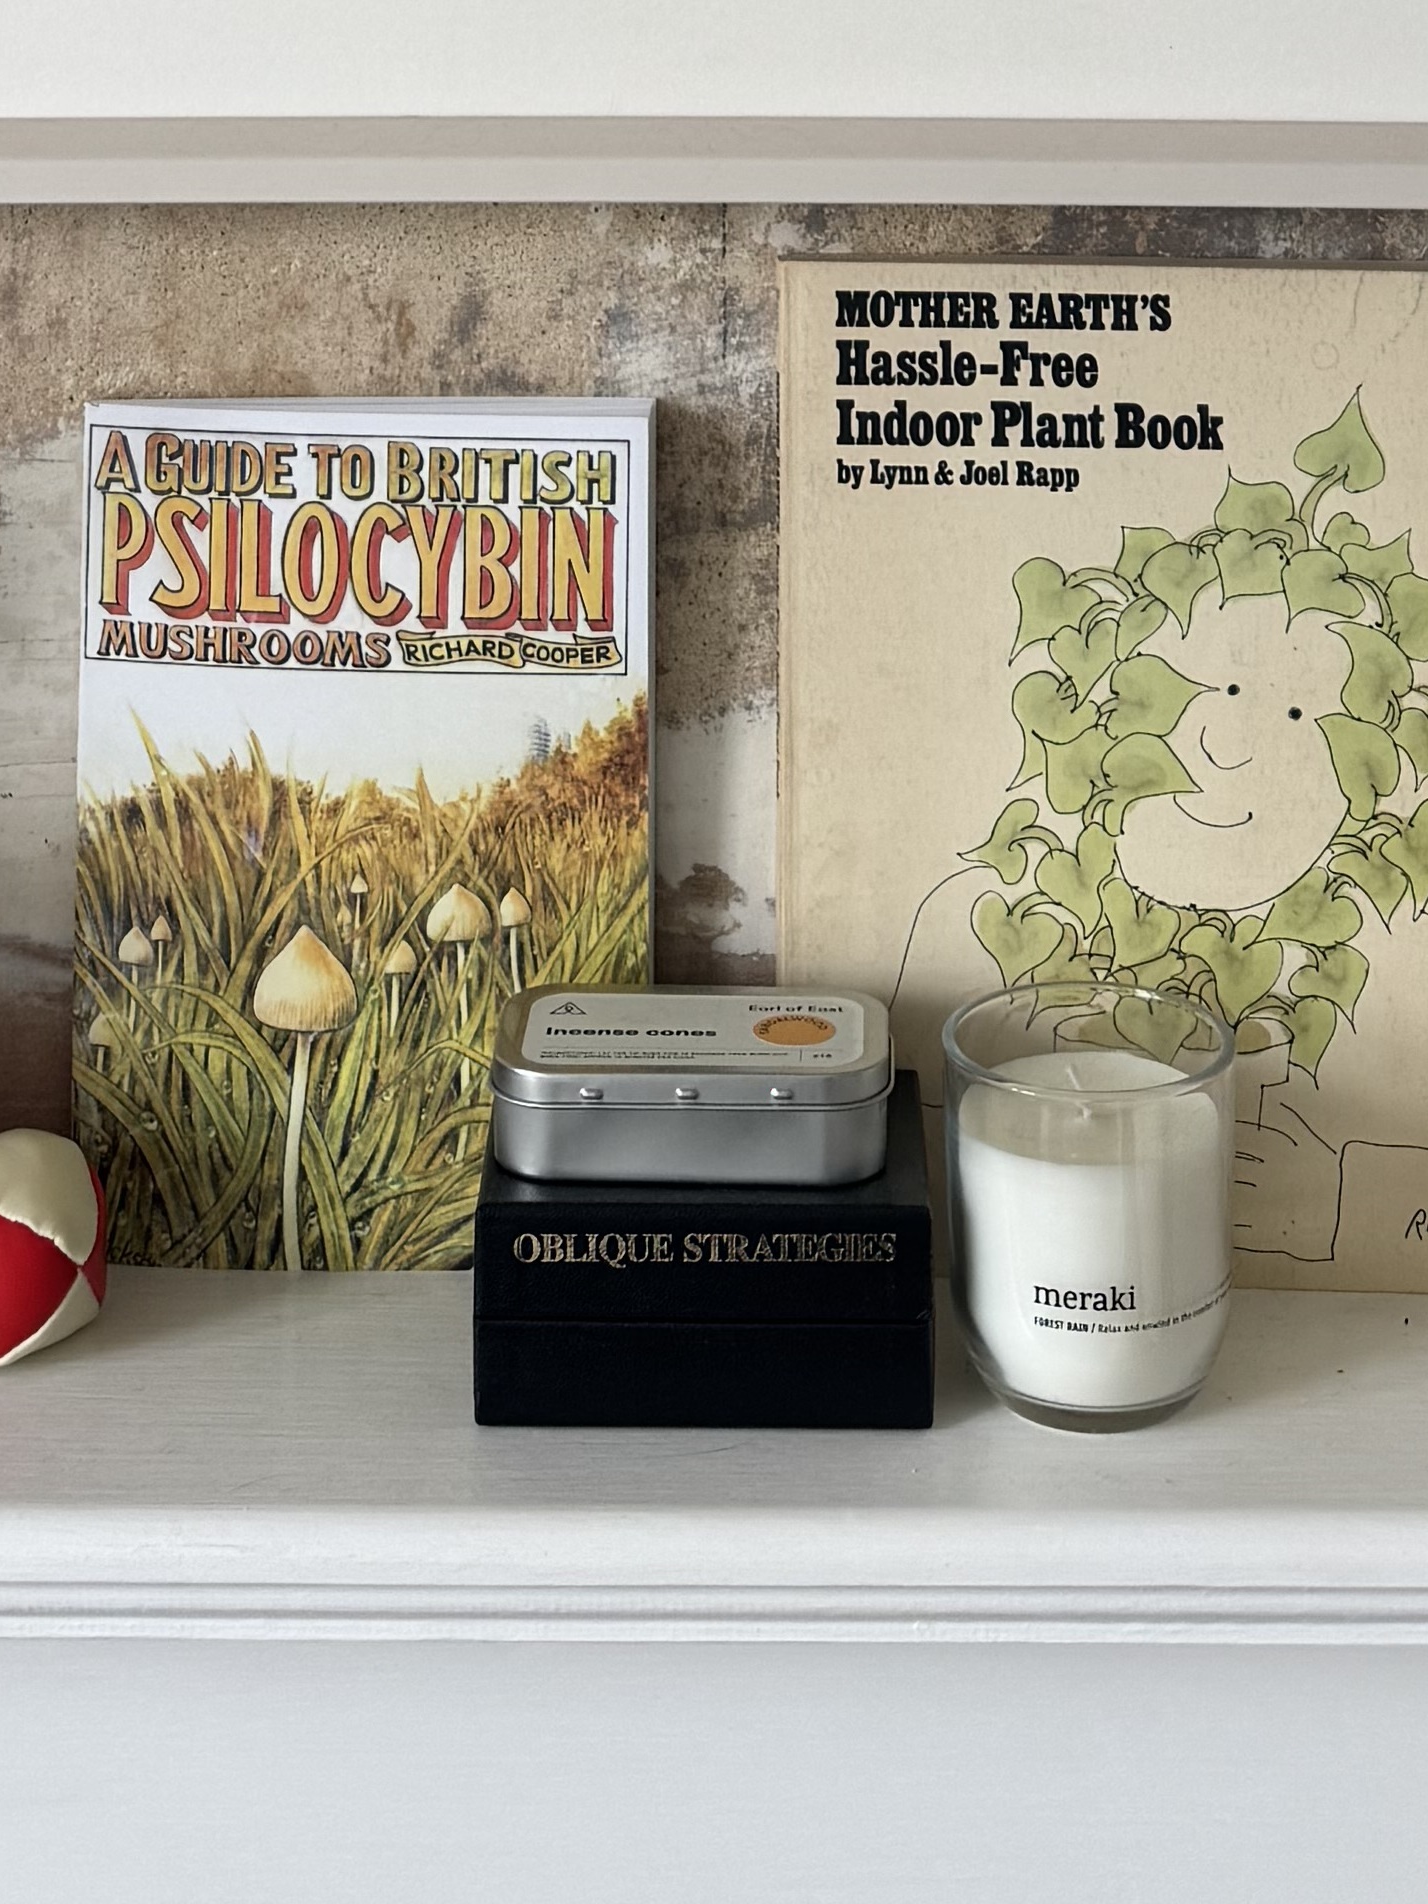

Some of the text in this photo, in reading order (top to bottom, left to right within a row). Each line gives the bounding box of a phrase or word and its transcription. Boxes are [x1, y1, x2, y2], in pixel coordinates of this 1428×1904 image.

[835, 290, 1172, 332] MOTHER EARTH'S
[835, 339, 1099, 388] Hassle-Free
[835, 399, 1224, 451] Indoor Plant Book
[94, 430, 615, 505] A GUIDE TO BRITISH
[836, 459, 1080, 492] by Lynn & Joel Rapp
[97, 493, 618, 631] PSILOCYBIN
[97, 618, 611, 669] MUSHROOMS RICHARD COOPER
[546, 1027, 717, 1037] Incense cones
[513, 1232, 897, 1268] OBLIQUE STRATEGIES
[1033, 1285, 1136, 1311] meraki
[1034, 1316, 1064, 1330] FOREST
